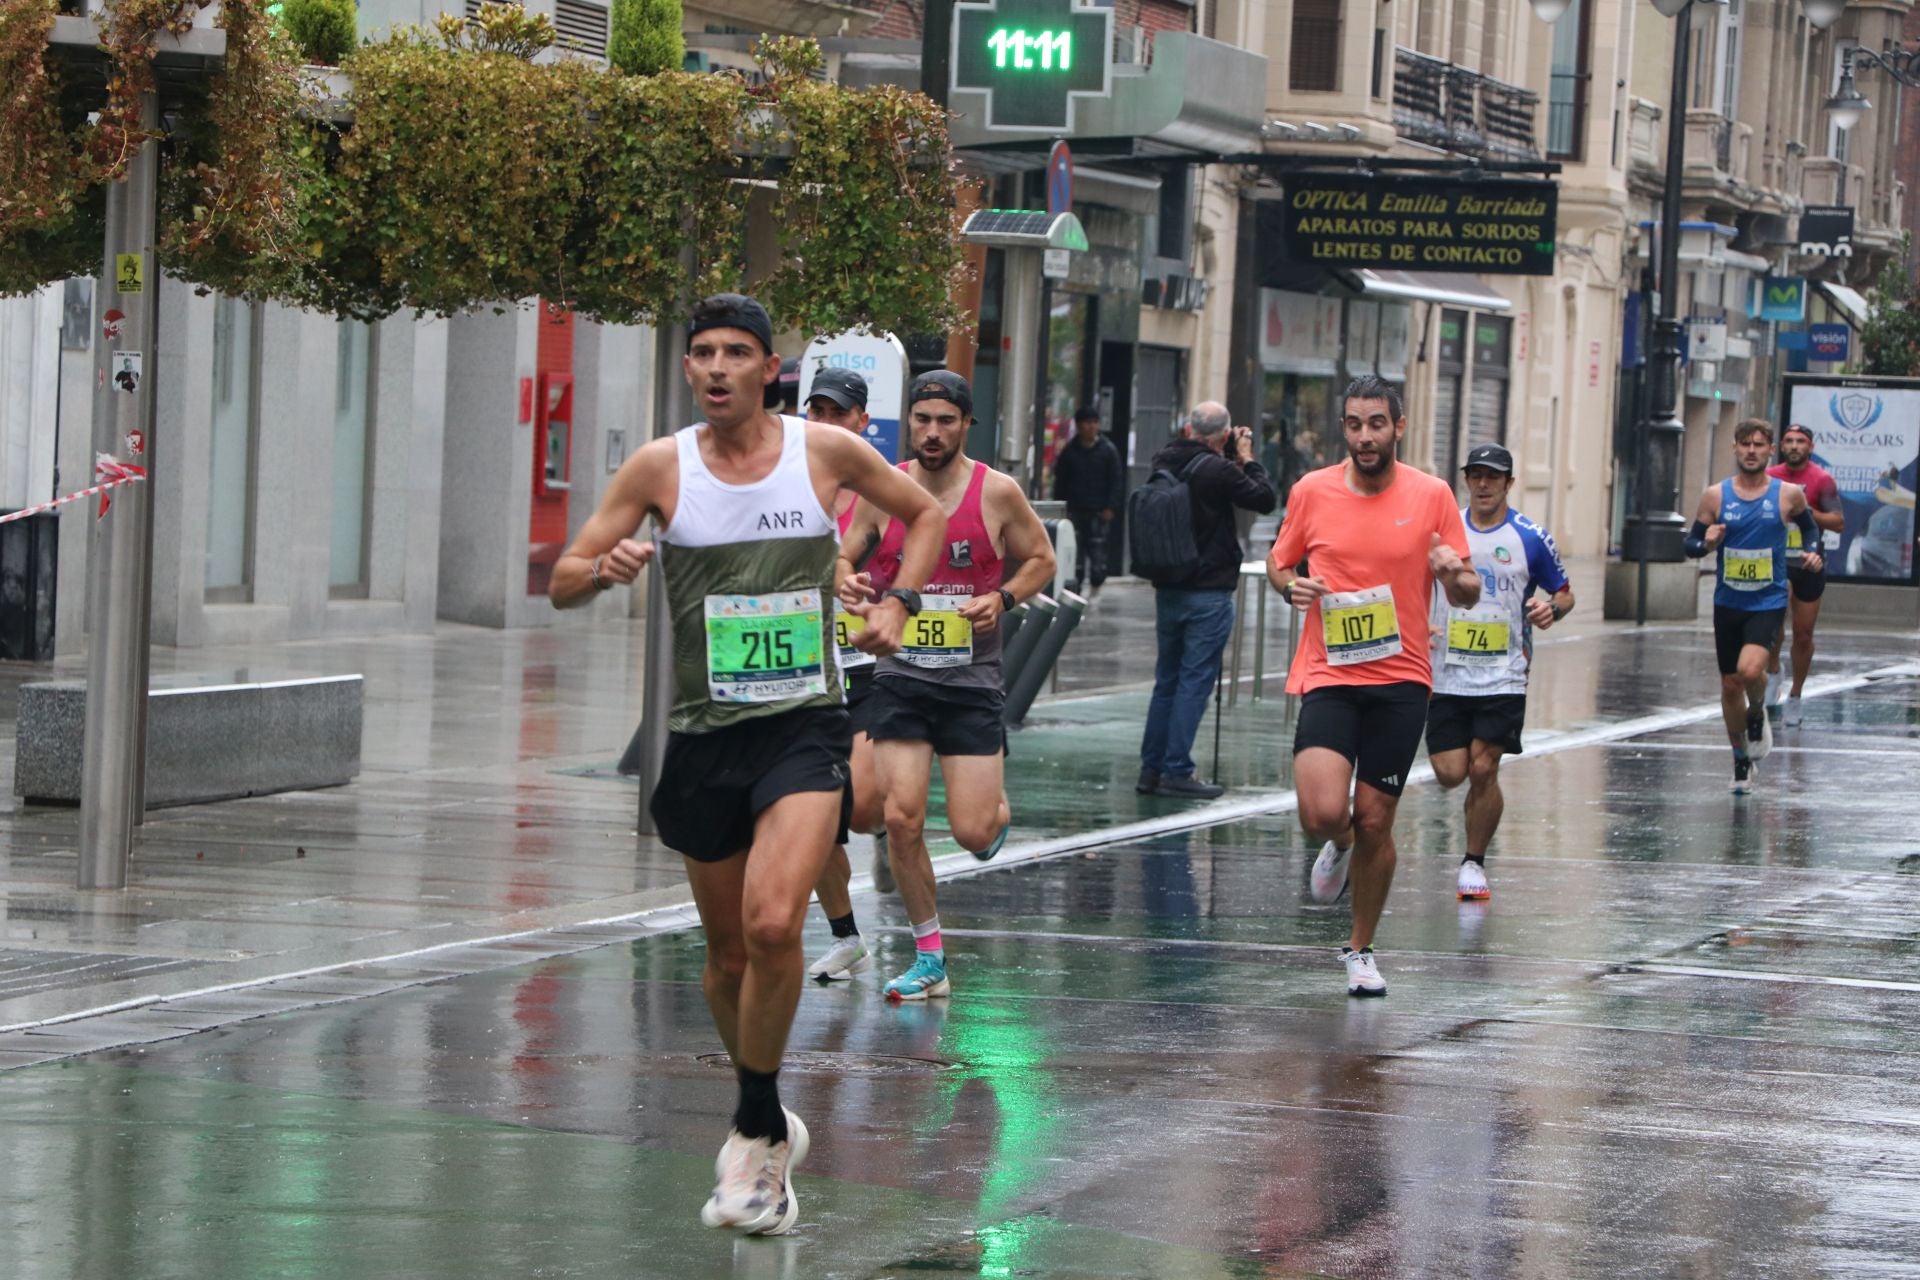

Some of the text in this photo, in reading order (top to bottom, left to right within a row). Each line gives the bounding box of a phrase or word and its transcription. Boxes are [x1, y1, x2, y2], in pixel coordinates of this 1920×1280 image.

[987, 28, 1072, 69] 11:11
[1293, 190, 1546, 216] OPTICA Emilia Barriada
[1297, 218, 1540, 241] APARATOS PARA SORDOS
[1312, 241, 1522, 265] LENTES DE CONTACTO
[829, 352, 876, 370] alsa
[757, 511, 804, 530] ANR
[1738, 564, 1757, 579] 48
[923, 583, 974, 594] orama
[917, 620, 944, 646] 58
[1342, 613, 1375, 642] 107
[741, 629, 794, 670] 215
[1467, 629, 1489, 650] 74
[755, 680, 807, 692] HYUNDAI
